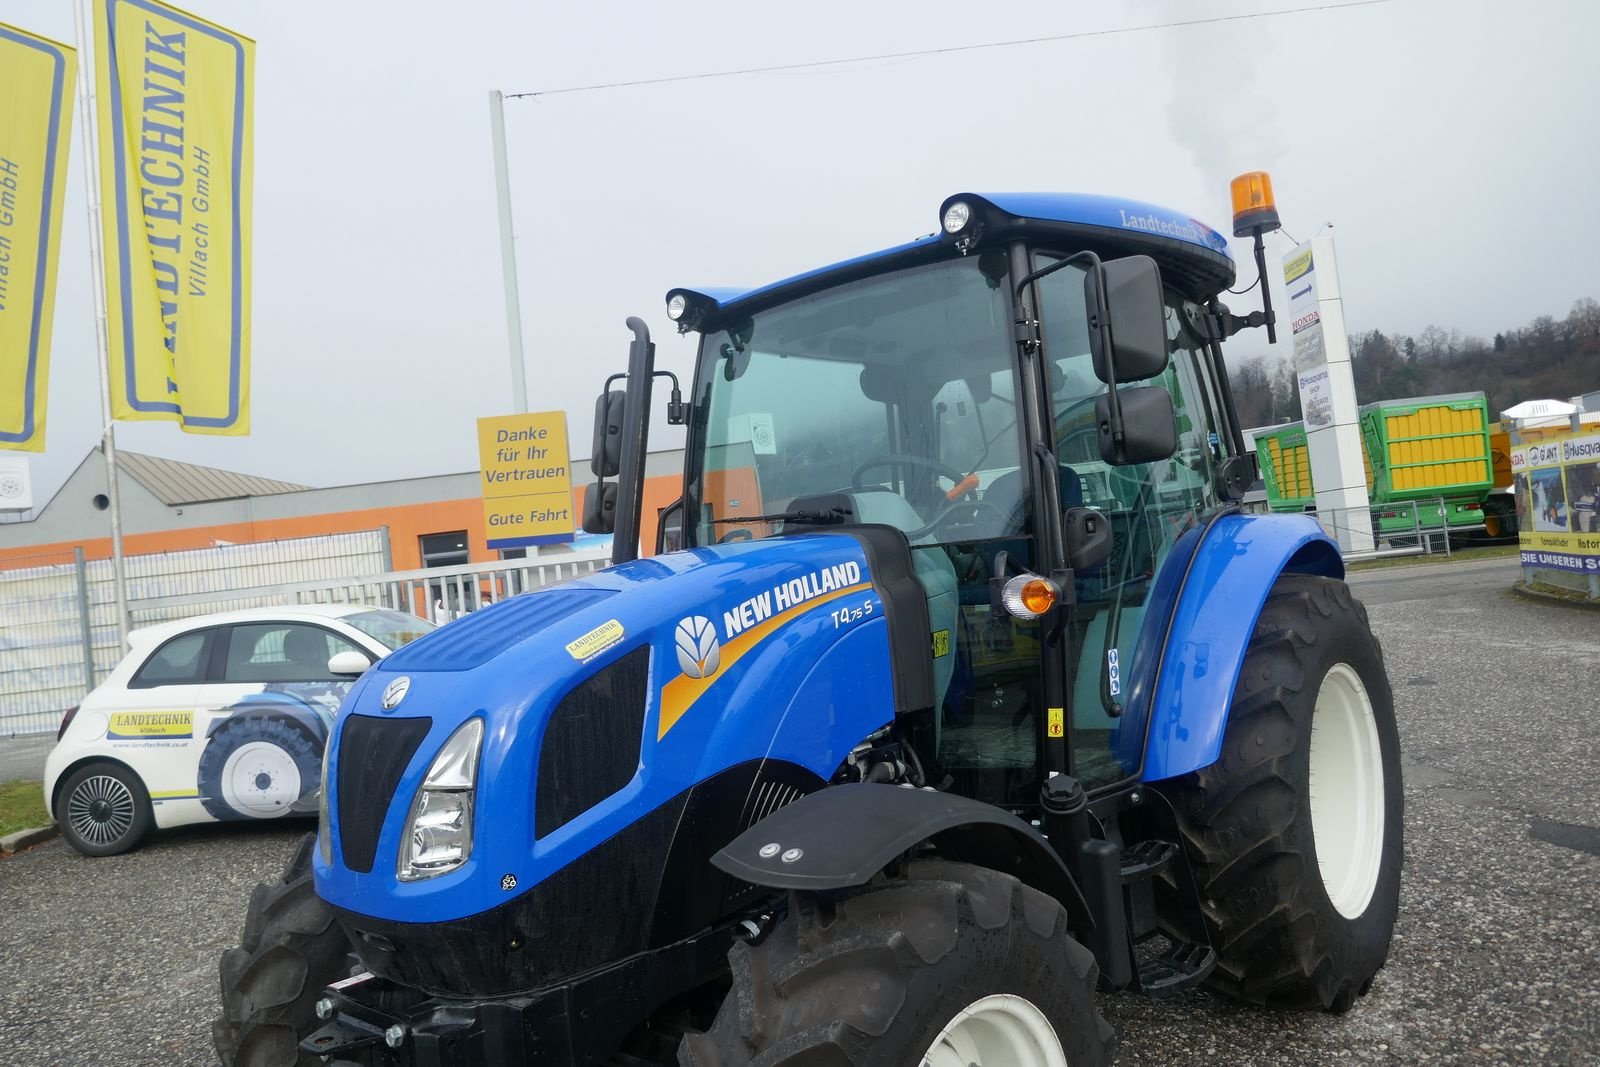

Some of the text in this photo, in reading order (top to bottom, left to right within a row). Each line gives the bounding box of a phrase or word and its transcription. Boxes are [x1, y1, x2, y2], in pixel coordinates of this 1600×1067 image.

[140, 20, 188, 394] DTECHNIK
[189, 145, 211, 297] Villach GmbH
[1292, 311, 1320, 330] HONDA
[497, 427, 548, 443] Danke
[497, 446, 548, 463] für Ihr
[485, 466, 566, 484] Vertrauen
[488, 508, 568, 526] Gute Fahrt
[1521, 552, 1600, 570] SIE UNSEREN S
[723, 560, 861, 639] NEW HOLLAND
[831, 599, 873, 630] T4.75 S
[568, 621, 617, 652] LANDTECHNIK
[116, 712, 192, 727] LANDTECHNIK
